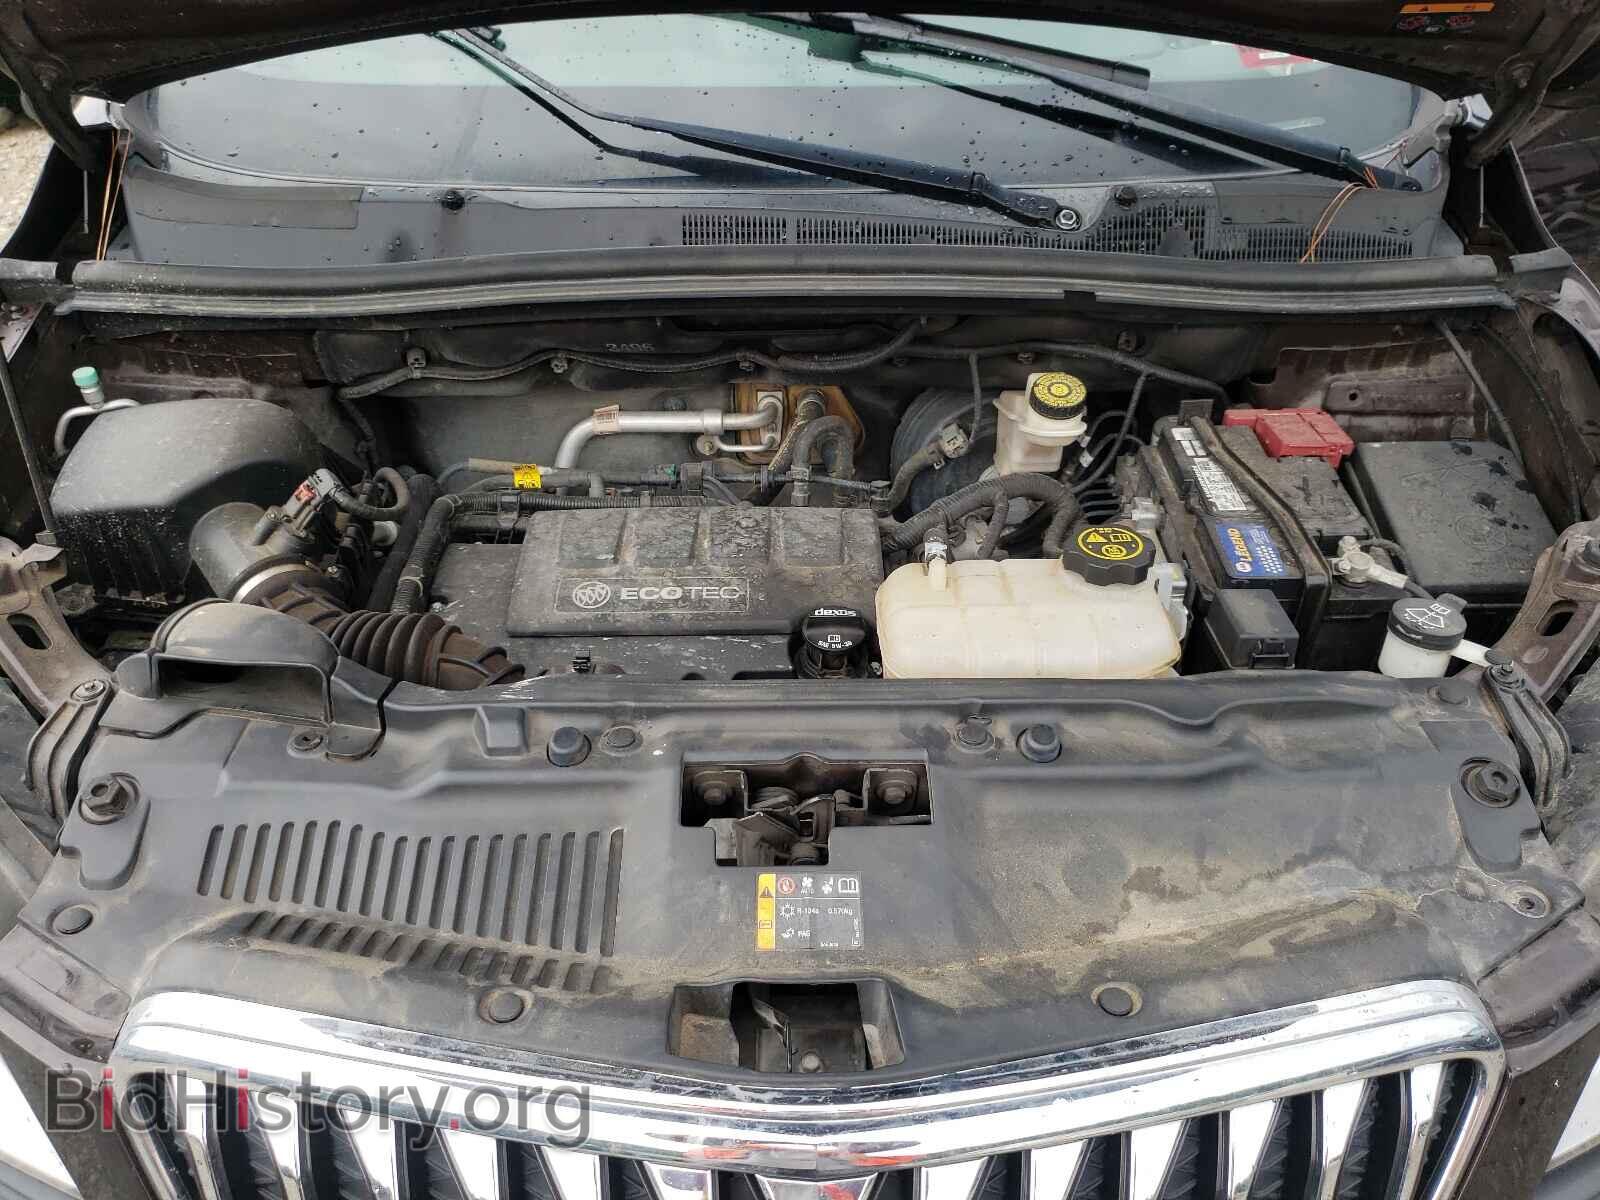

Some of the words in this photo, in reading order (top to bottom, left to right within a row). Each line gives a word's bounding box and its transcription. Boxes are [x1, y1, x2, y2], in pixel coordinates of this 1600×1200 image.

[1226, 527, 1253, 563] LEGEND
[620, 586, 744, 601] ECOTEC
[814, 607, 857, 617] dexos
